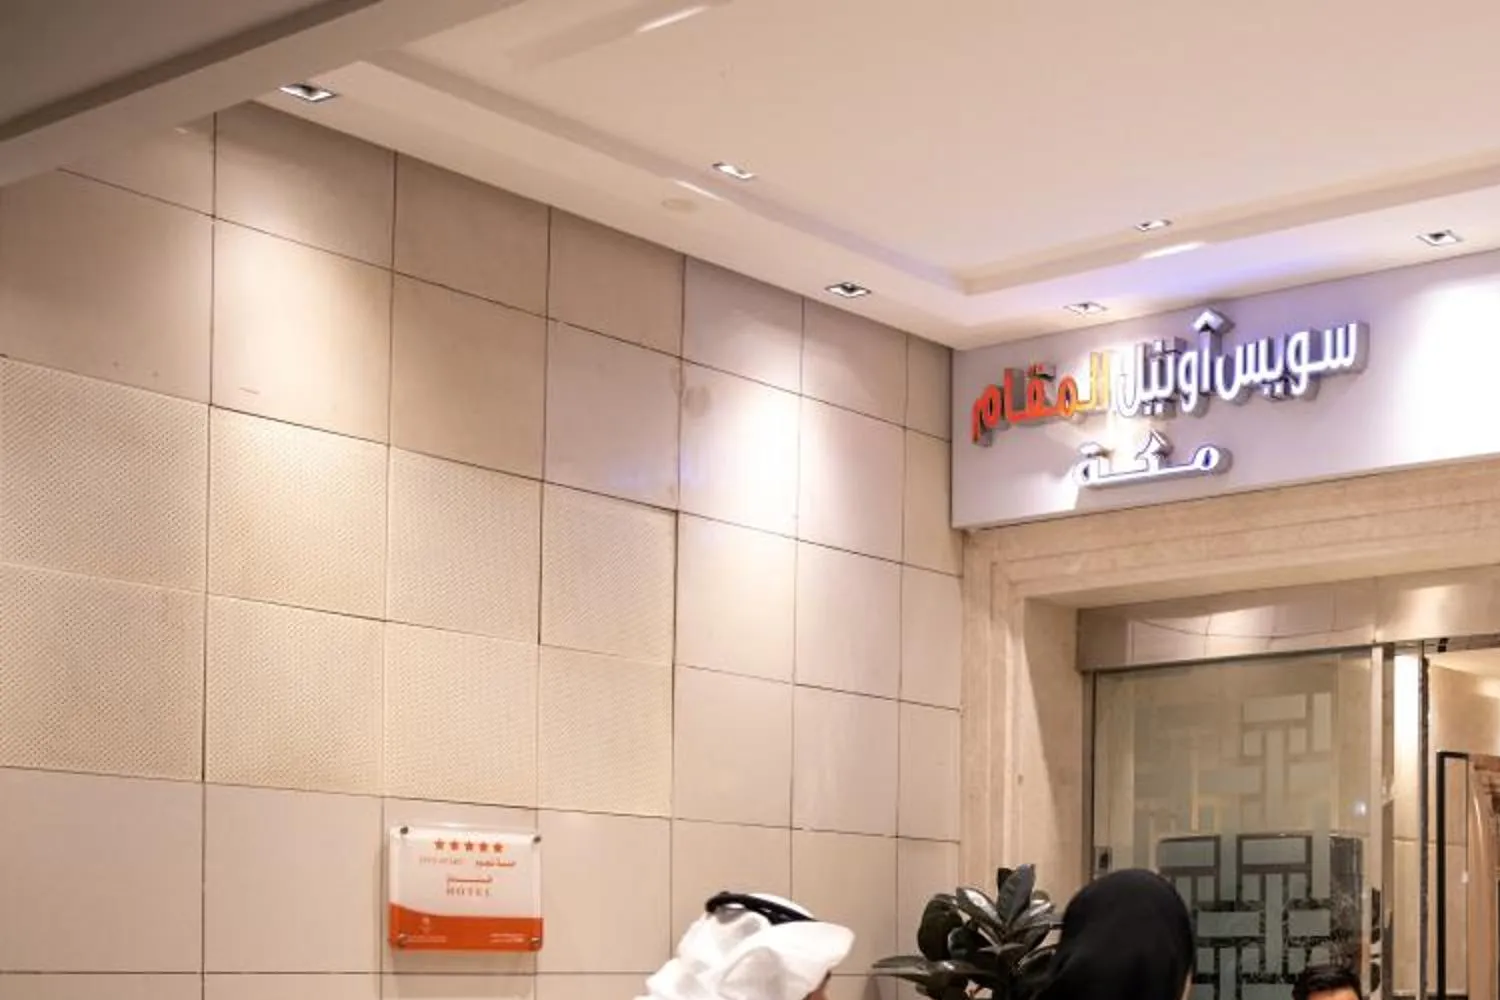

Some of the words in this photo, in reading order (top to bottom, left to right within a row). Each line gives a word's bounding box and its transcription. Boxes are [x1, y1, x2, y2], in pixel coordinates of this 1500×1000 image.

[971, 350, 1112, 444] المقام
[1073, 429, 1222, 487] مكة
[446, 886, 491, 897] HOTEL
